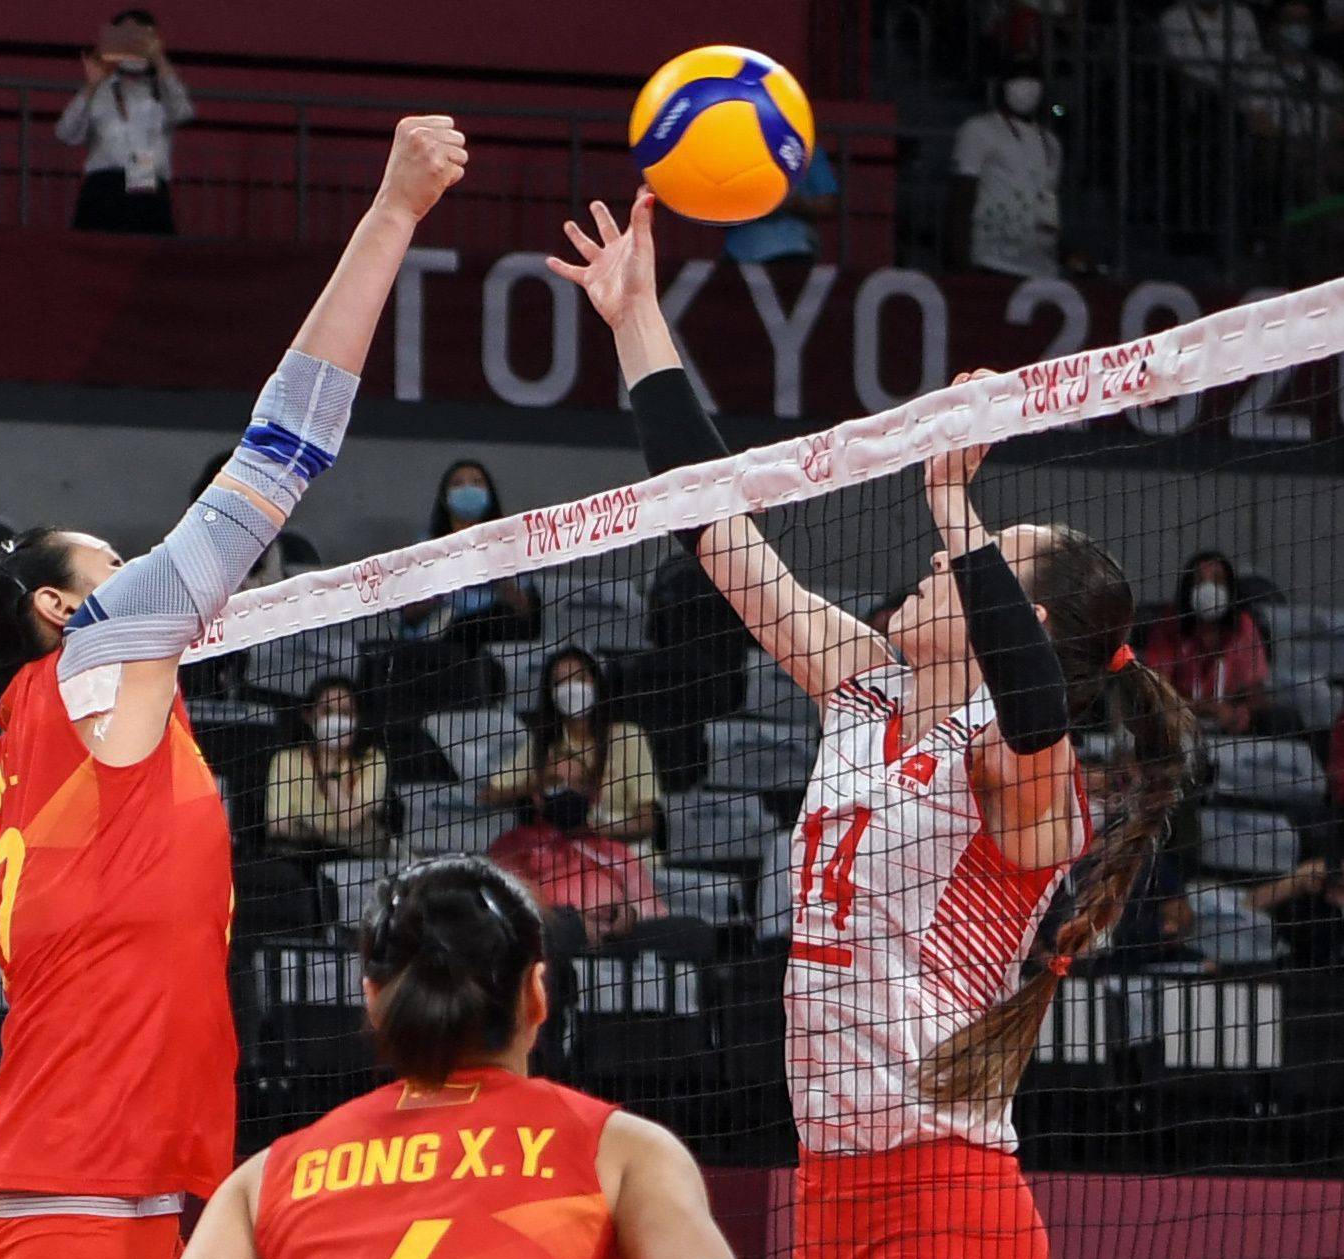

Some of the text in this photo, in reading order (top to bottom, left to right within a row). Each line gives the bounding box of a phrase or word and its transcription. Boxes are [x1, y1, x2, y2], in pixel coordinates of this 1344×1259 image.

[395, 247, 948, 418] TOKYO
[1019, 355, 1091, 417] TOKYO
[523, 486, 638, 557] TOKYO 2020
[795, 804, 873, 931] 14
[291, 1131, 442, 1201] GONG
